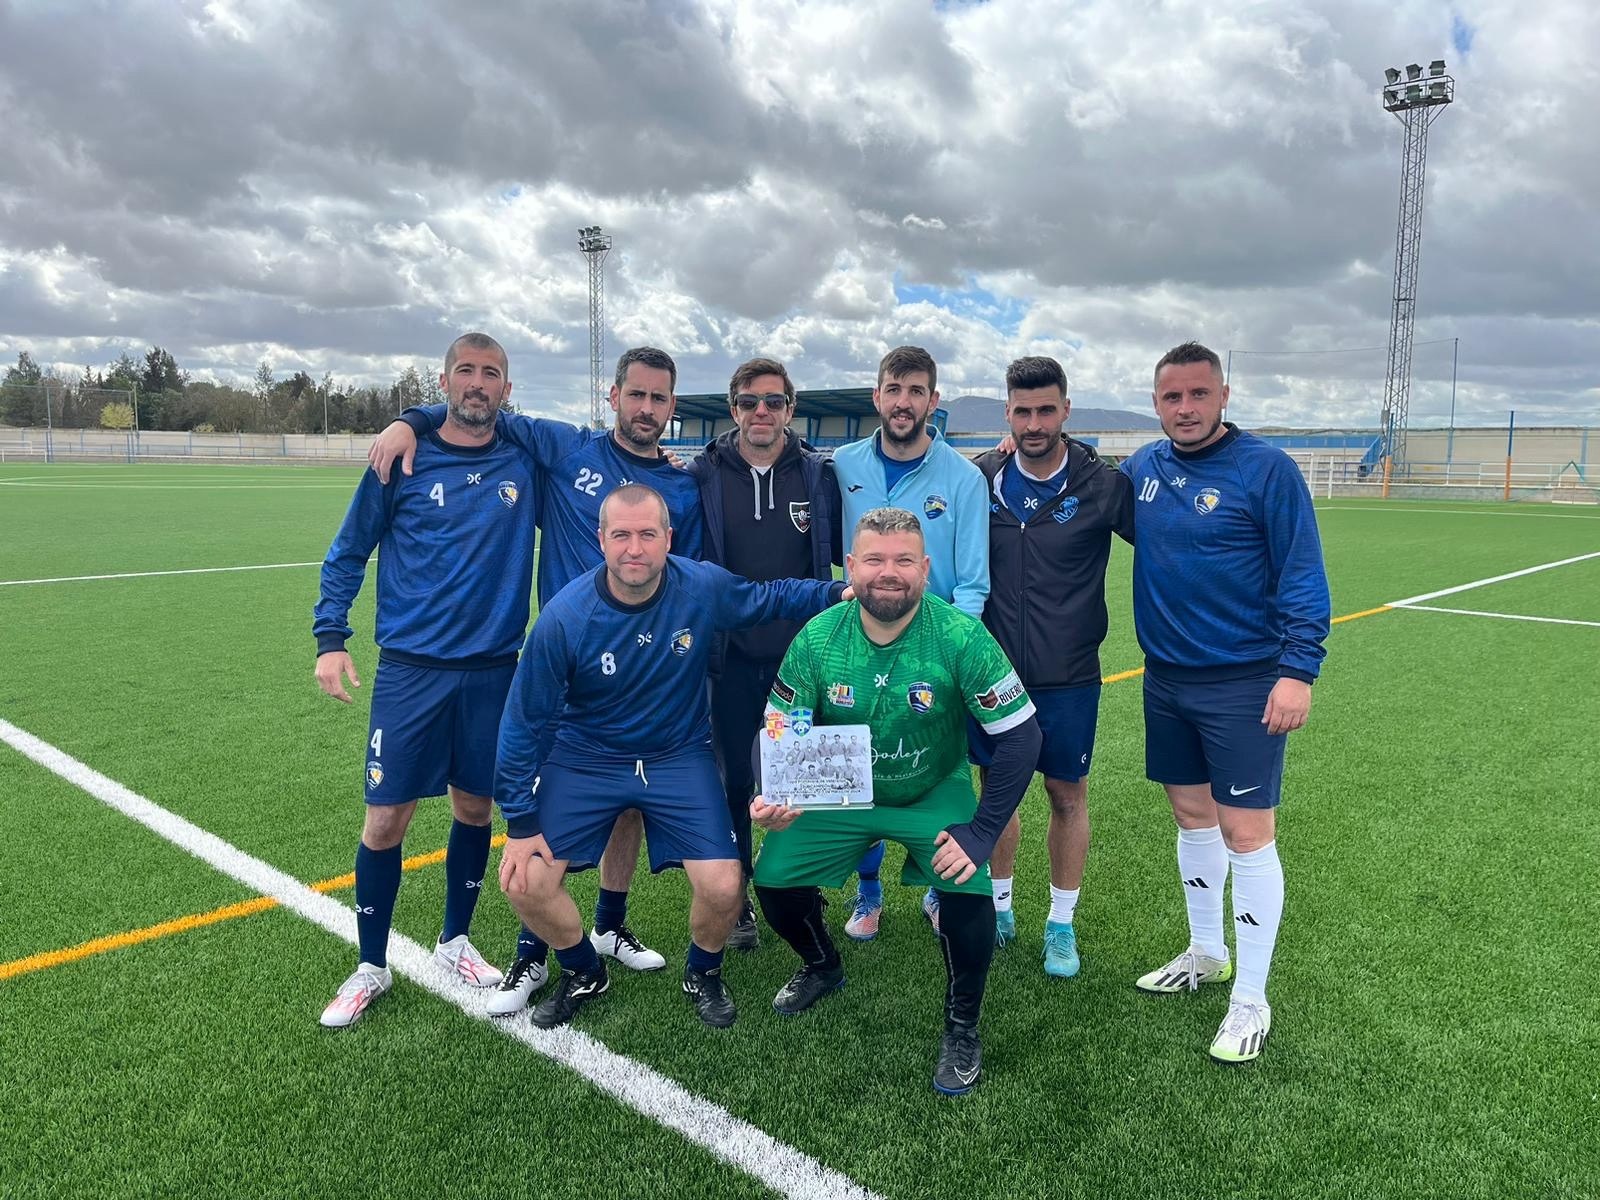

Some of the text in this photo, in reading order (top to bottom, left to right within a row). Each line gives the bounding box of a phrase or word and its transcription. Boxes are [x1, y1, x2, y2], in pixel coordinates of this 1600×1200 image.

[429, 482, 445, 507] 4
[574, 467, 603, 497] 22
[1138, 476, 1160, 503] 10
[600, 651, 617, 676] 8
[370, 728, 383, 757] 4
